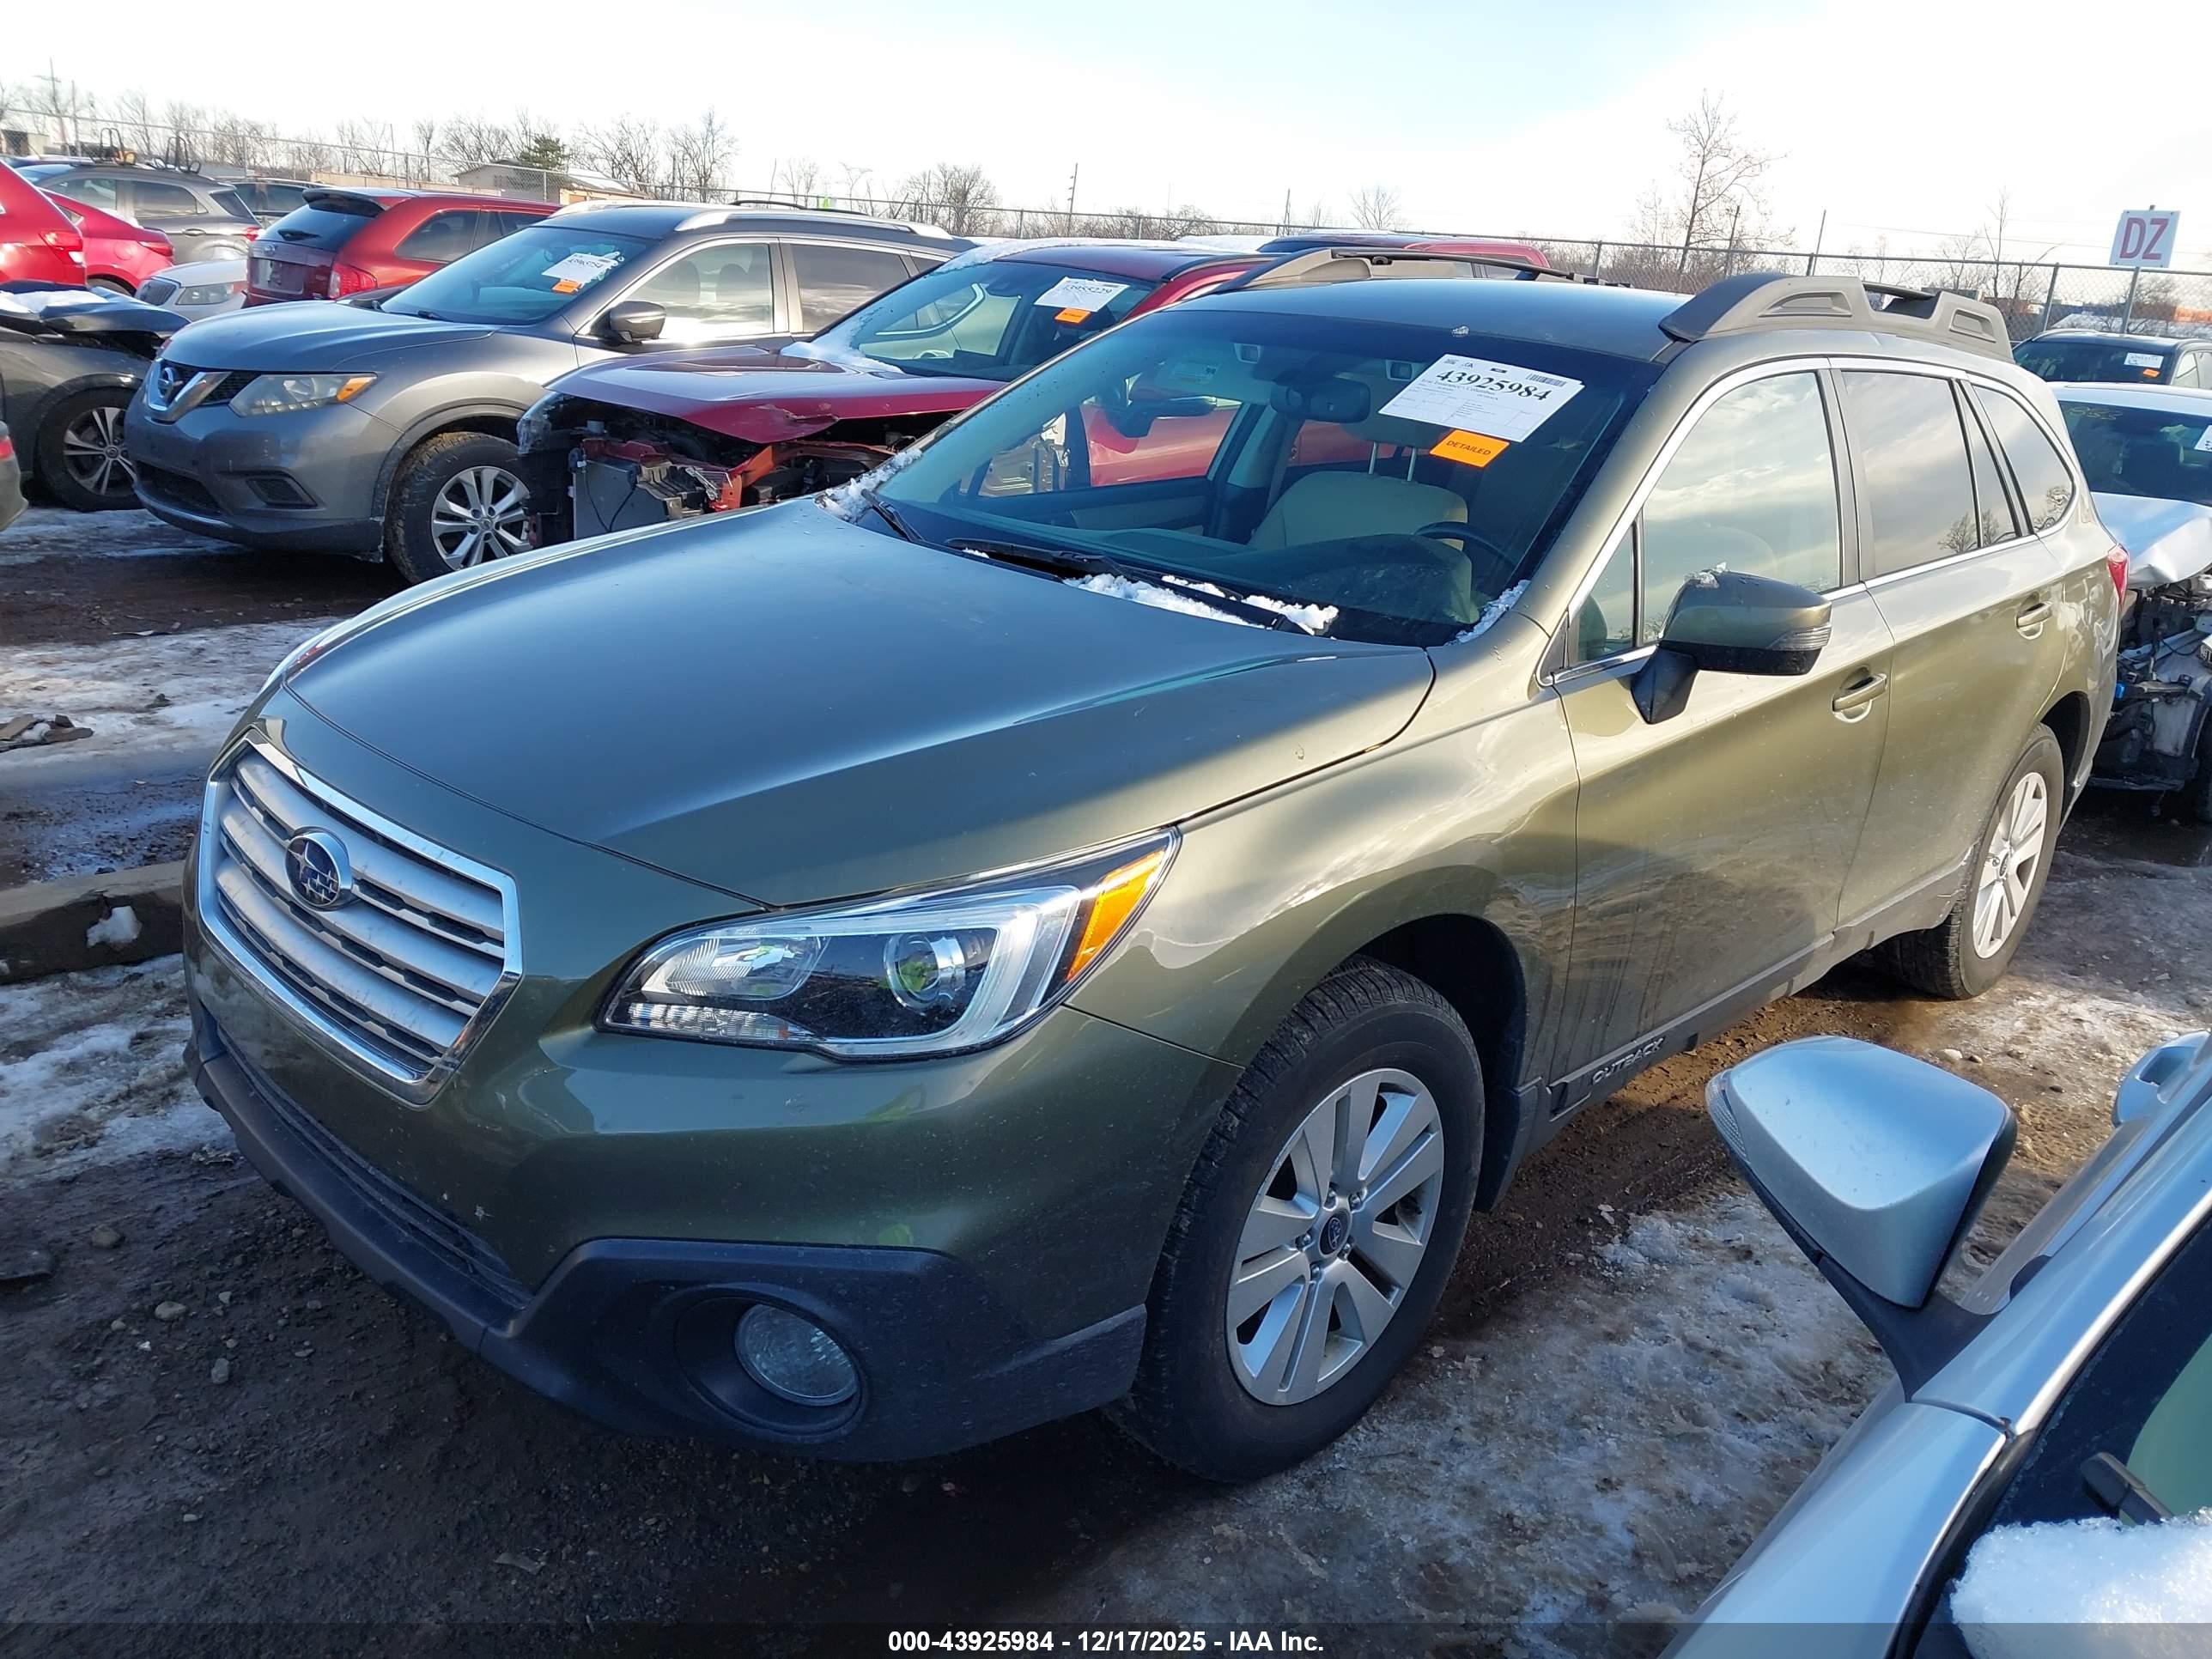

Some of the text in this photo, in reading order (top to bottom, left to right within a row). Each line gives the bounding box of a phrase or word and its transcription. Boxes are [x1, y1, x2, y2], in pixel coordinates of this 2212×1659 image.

[2119, 217, 2169, 260] DZ
[1437, 369, 1553, 401] 43925984
[1446, 439, 1492, 456] DETAILED
[1592, 1037, 1664, 1085] OUTBACK
